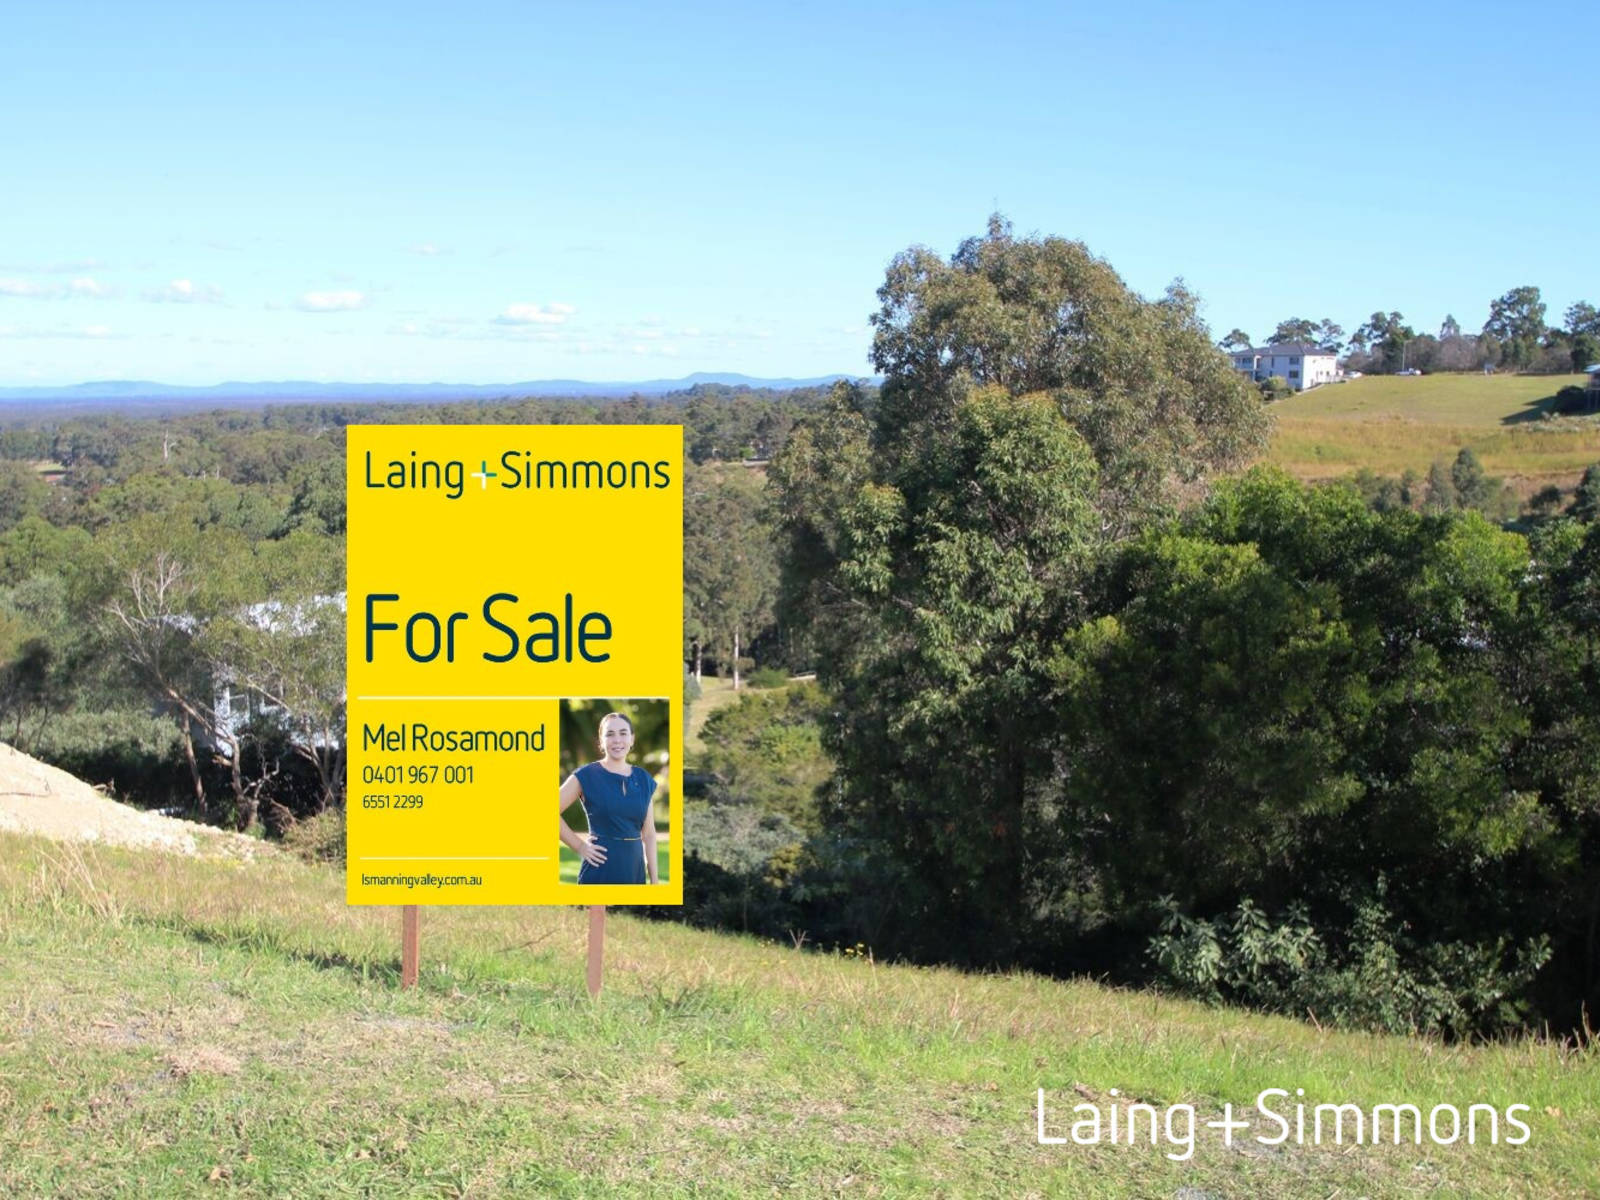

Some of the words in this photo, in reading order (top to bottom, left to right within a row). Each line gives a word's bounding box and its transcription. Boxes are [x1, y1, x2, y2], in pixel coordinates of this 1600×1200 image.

[365, 593, 469, 664] For
[482, 592, 613, 664] Sale
[363, 723, 406, 752] Mel
[412, 723, 545, 752] Rosamond
[362, 765, 403, 784] 0401
[408, 765, 439, 784] 967
[444, 765, 473, 784] 001
[362, 794, 390, 809] 6551
[393, 794, 424, 809] 2299
[361, 873, 482, 889] lsmanningvalley.com.au
